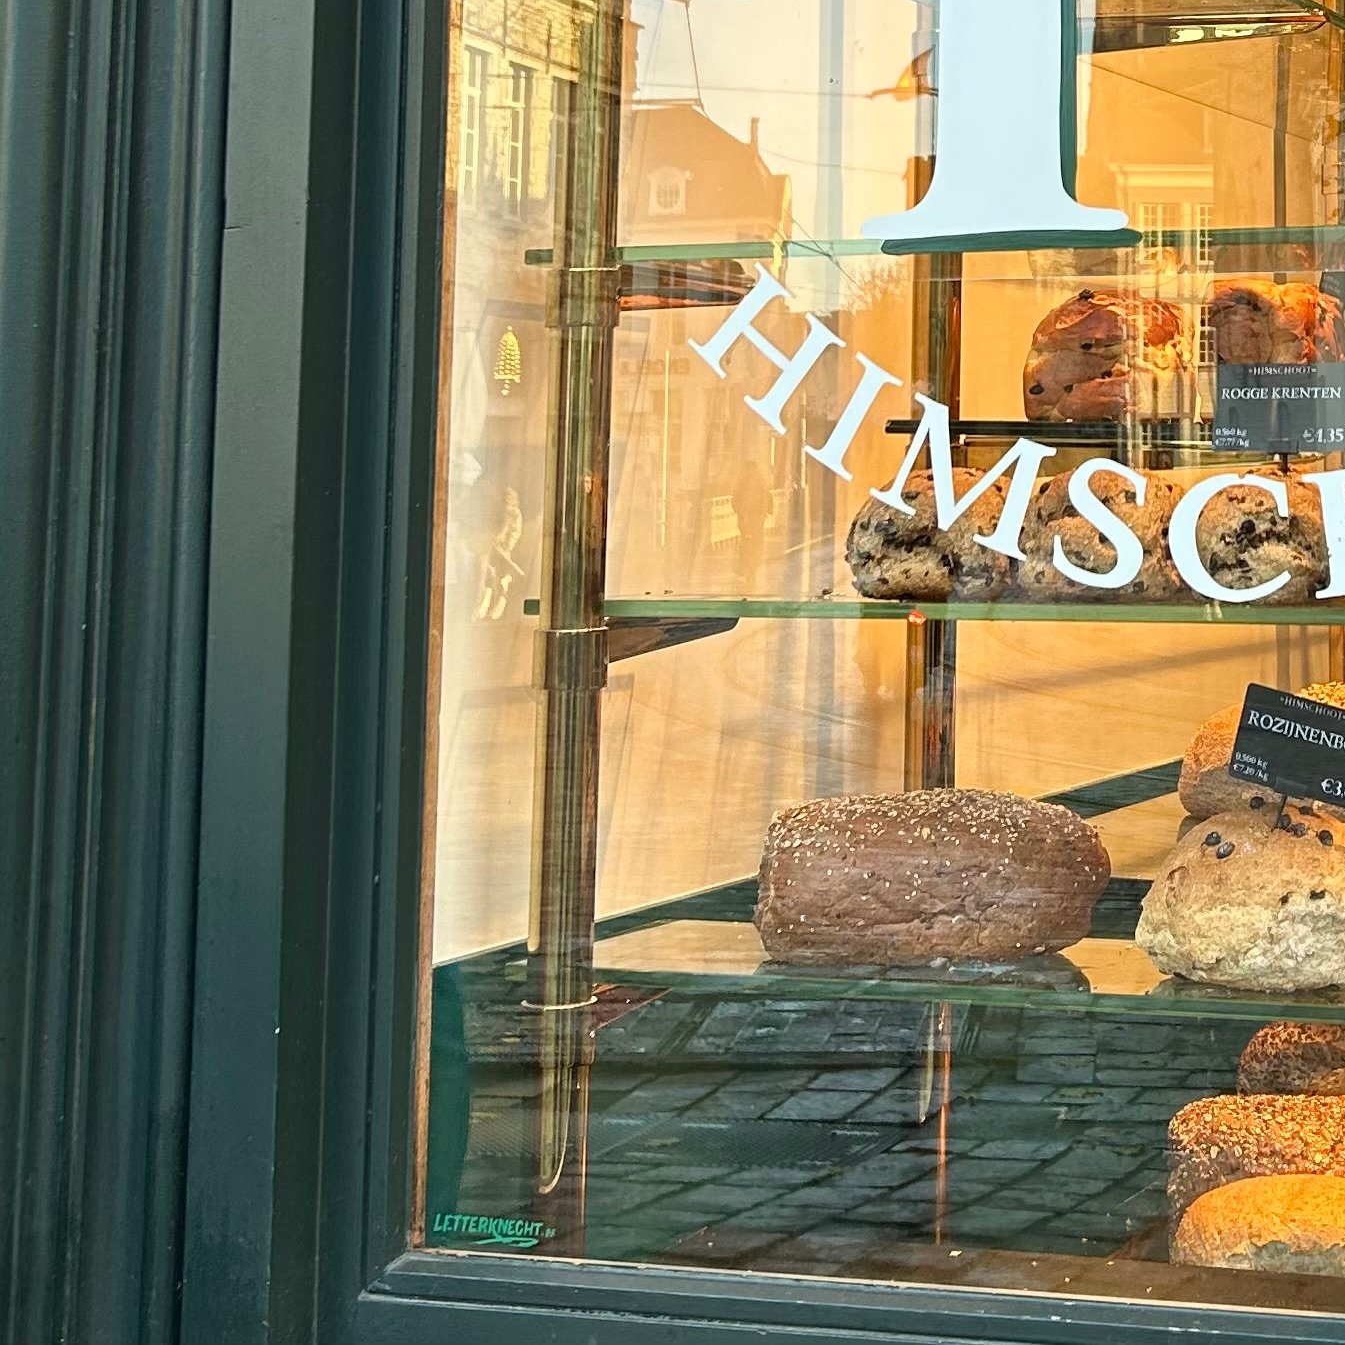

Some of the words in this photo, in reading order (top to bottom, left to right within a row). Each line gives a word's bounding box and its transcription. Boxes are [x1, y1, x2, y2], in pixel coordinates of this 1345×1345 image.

[1221, 387, 1269, 400] ROGGE
[1271, 386, 1342, 400] KRENTEN
[1284, 696, 1343, 721] HIMSCHOOT
